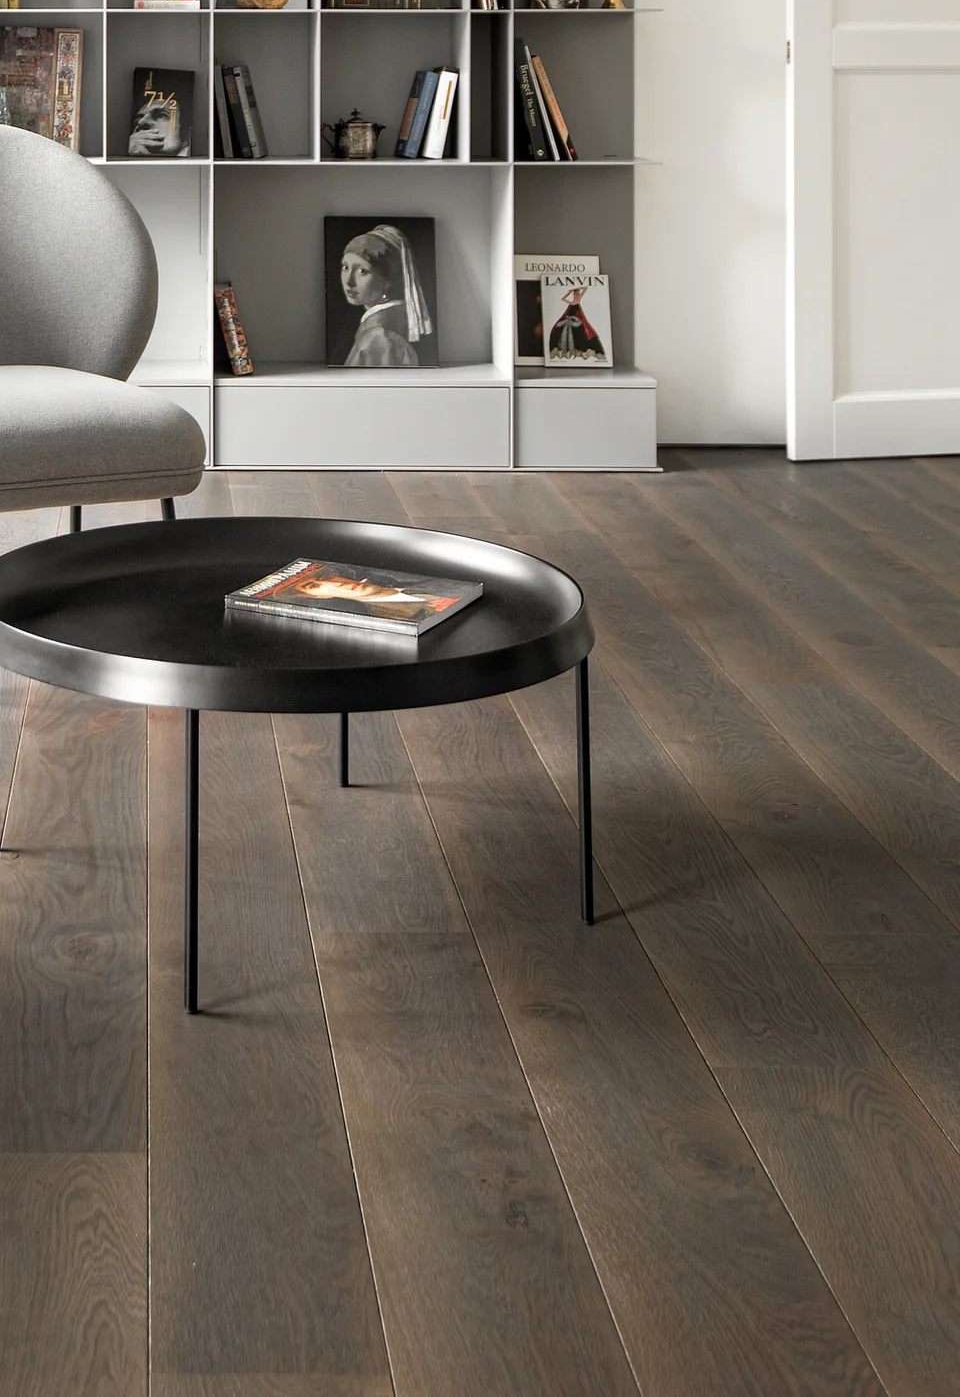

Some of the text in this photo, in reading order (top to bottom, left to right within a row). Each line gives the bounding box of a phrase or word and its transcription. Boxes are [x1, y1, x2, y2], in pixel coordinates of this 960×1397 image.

[520, 64, 534, 96] Bruegel
[525, 263, 586, 273] LEONARDO
[545, 276, 605, 286] LANVIN
